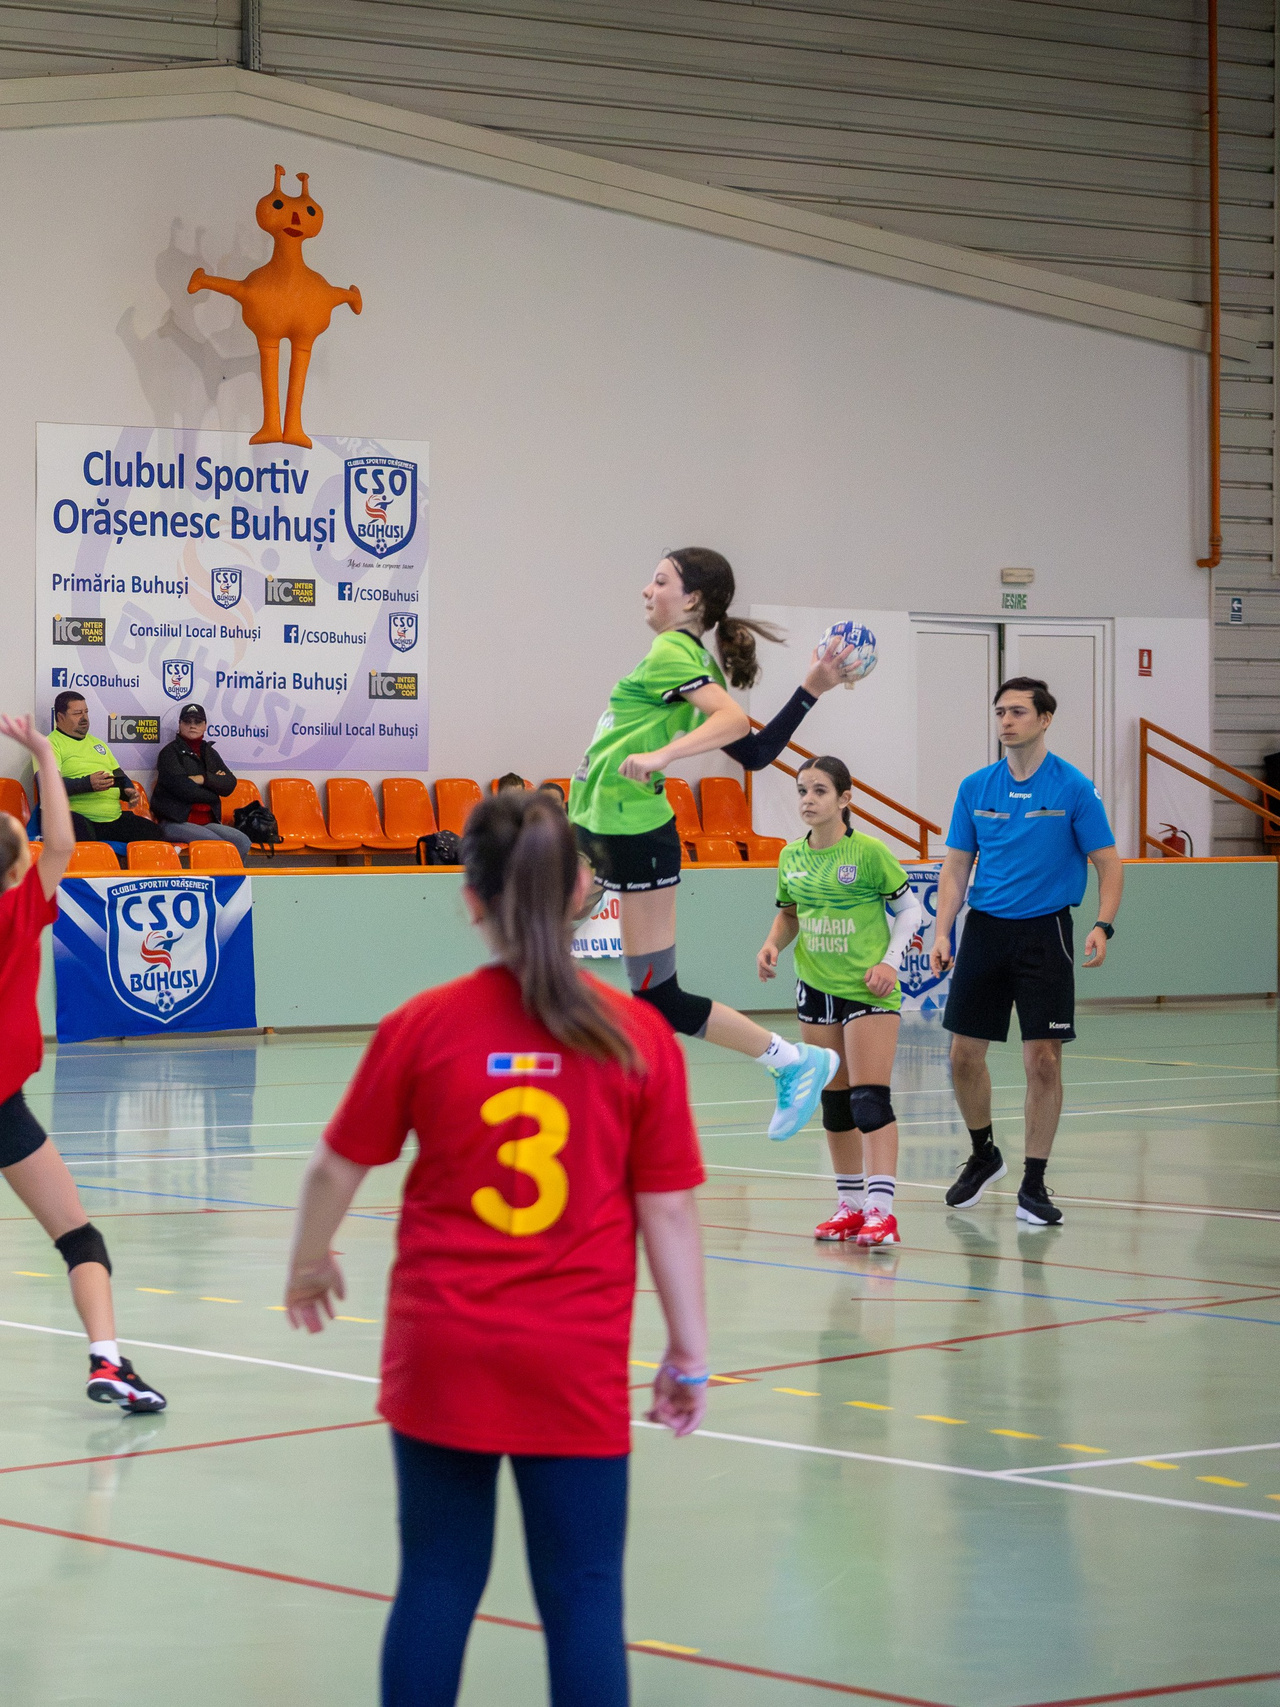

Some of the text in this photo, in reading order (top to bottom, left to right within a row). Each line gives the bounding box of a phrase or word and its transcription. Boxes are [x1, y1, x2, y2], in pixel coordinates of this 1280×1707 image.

[82, 450, 309, 500] Clubul Sportiv
[354, 467, 407, 497] CSO
[52, 498, 336, 551] Orășenesc Buhuși
[52, 573, 189, 599] Primăria Buhuși
[215, 572, 238, 584] CSO
[354, 587, 419, 602] /CSOBuhusi
[83, 621, 103, 629] INTER
[392, 616, 414, 628] CSO
[129, 623, 261, 643] Consiliul Local Buhuși
[300, 629, 366, 645] /CSOBuhusi
[166, 664, 190, 675] CSO
[69, 673, 140, 689] /CSOBuhusi
[215, 671, 348, 695] Primăria Buhuși
[138, 719, 158, 727] INTER
[291, 722, 419, 740] Consiliul Local Buhuși
[111, 882, 138, 896] CLUBUL
[139, 879, 169, 890] SPORTIV
[121, 892, 200, 932] CSO
[130, 969, 199, 993] BUHUȘI
[471, 1085, 569, 1237] 3
